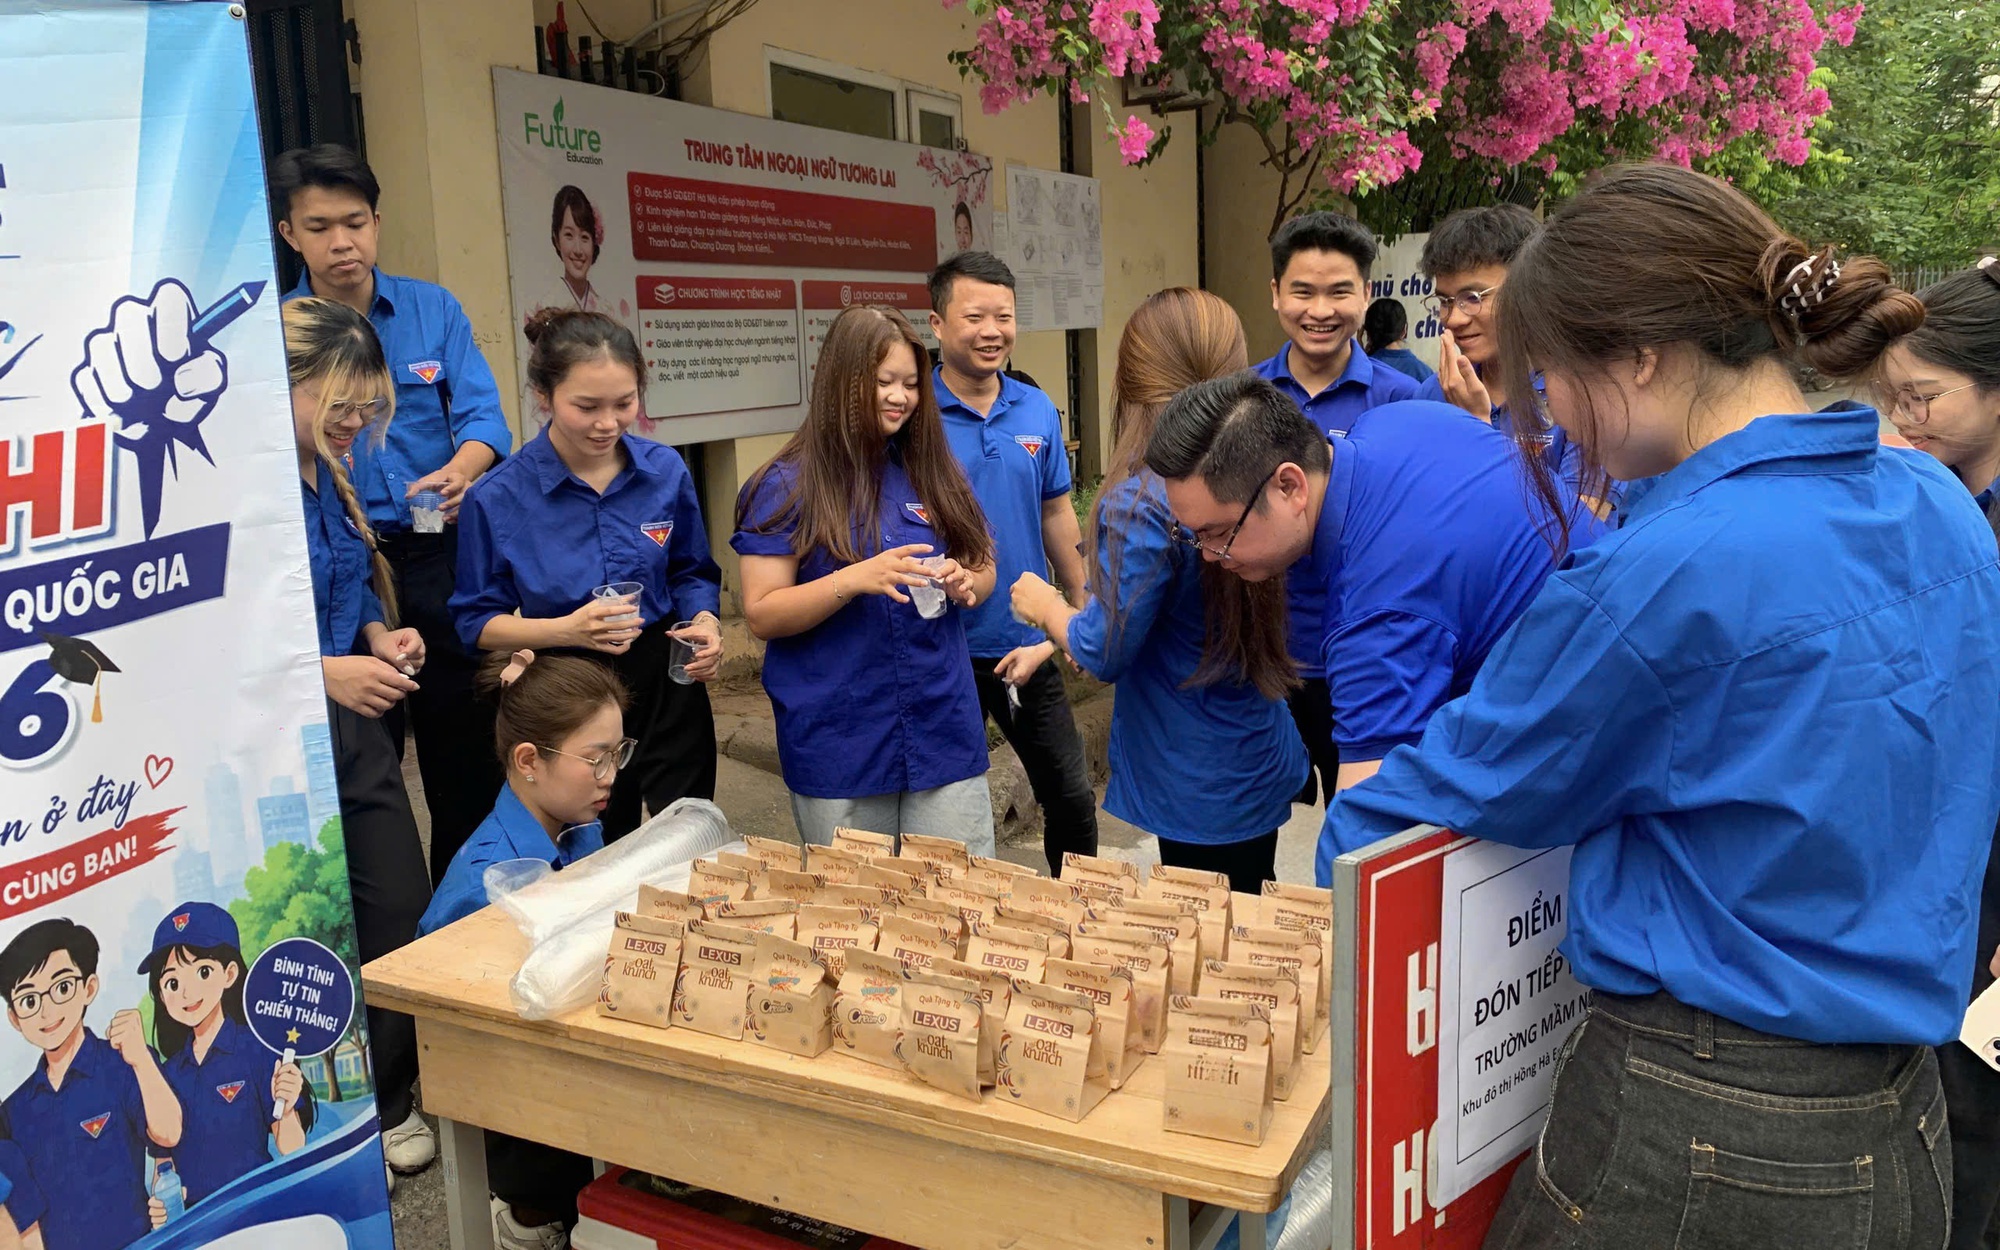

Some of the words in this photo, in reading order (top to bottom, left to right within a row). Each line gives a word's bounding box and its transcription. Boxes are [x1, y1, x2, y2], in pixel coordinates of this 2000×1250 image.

[524, 110, 601, 153] Future
[566, 151, 603, 165] Education
[684, 139, 733, 166] TRUNG
[736, 143, 764, 170] TÂM
[767, 151, 808, 181] NGOẠI
[811, 157, 837, 180] NGỮ
[839, 162, 877, 185] TƯƠNG
[879, 168, 896, 188] LAI
[673, 190, 696, 202] GD&ĐT
[649, 237, 669, 247] Thanh
[1400, 273, 1432, 297] cho
[678, 288, 709, 299] CHƯƠNG
[711, 286, 731, 299] TRÌNH
[731, 288, 746, 302] HỌC
[747, 286, 765, 299] TIẾNG
[766, 288, 782, 302] NHẬT
[853, 290, 863, 301] LỢI
[863, 289, 871, 300] ÍCH
[872, 291, 883, 300] CHO
[885, 291, 896, 303] HỌC
[896, 292, 908, 301] SINH
[655, 319, 664, 330] Sử
[664, 319, 680, 331] dụng
[681, 319, 696, 328] sách
[697, 319, 709, 331] giáo
[710, 319, 725, 328] khoa
[726, 319, 734, 327] do
[735, 319, 742, 329] Bộ
[743, 318, 762, 328] GD&ĐT
[763, 319, 775, 328] biên
[775, 320, 788, 329] soạn
[656, 339, 671, 349] Giáo
[672, 339, 684, 348] viên
[685, 338, 694, 348] tốt
[694, 337, 713, 350] nghiệp
[714, 337, 723, 348] đại
[724, 337, 734, 348] học
[735, 337, 754, 348] chuyên
[754, 336, 771, 346] ngành
[772, 335, 783, 346] tiếng
[784, 335, 796, 345] Nhật
[657, 359, 669, 370] Xây
[670, 358, 686, 369] dựng
[689, 358, 700, 367] các
[707, 357, 722, 367] năng
[723, 357, 733, 367] học
[734, 356, 749, 367] ngoại
[674, 370, 684, 380] viết
[687, 370, 698, 381] một
[700, 369, 715, 379] cách
[715, 368, 727, 379] hiệu
[4, 561, 121, 633] QUỐC
[132, 553, 190, 600] GIA
[43, 796, 68, 834] ở
[77, 774, 141, 829] đây
[3, 862, 76, 905] CÙNG
[84, 835, 137, 878] BẠN!
[818, 922, 832, 930] Quà
[834, 921, 849, 932] Tặng
[1507, 890, 1561, 948] ĐIỂM
[627, 940, 665, 954] LEXUS
[815, 937, 858, 950] LEXUS
[900, 933, 913, 942] Quà
[914, 936, 929, 947] Tặng
[701, 949, 740, 964] LEXUS
[773, 952, 785, 960] Quà
[786, 954, 800, 965] Tặng
[896, 950, 932, 968] LEXUS
[984, 955, 1027, 970] LEXUS
[273, 956, 304, 978] BÌNH
[307, 965, 334, 987] TĨNH
[623, 963, 656, 980] krunch
[634, 958, 653, 971] oat
[862, 962, 876, 971] Quà
[877, 964, 890, 975] Tặng
[950, 968, 963, 976] Quà
[698, 970, 733, 990] krunch
[711, 967, 730, 980] oat
[1066, 969, 1080, 977] Quà
[1081, 970, 1097, 982] Tặng
[282, 981, 300, 1001] TỰ
[301, 985, 321, 1004] TIN
[1475, 981, 1521, 1027] ĐÓN
[1526, 947, 1563, 1000] TIẾP
[919, 994, 933, 1003] Quà
[934, 995, 951, 1007] Tặng
[1031, 999, 1045, 1008] Quà
[1046, 1001, 1063, 1013] Tặng
[255, 999, 292, 1019] CHIẾN
[295, 1006, 338, 1032] THẮNG!
[915, 1012, 958, 1031] LEXUS
[1026, 1016, 1073, 1037] LEXUS
[927, 1035, 946, 1049] oat
[1036, 1038, 1057, 1054] oat
[1475, 1022, 1538, 1075] TRƯỜNG
[1541, 1002, 1575, 1037] MẦM
[917, 1038, 952, 1060] krunch
[1023, 1042, 1062, 1066] krunch
[1462, 1097, 1482, 1117] Khu
[1484, 1086, 1497, 1105] đô
[1498, 1075, 1512, 1095] thị
[1513, 1056, 1537, 1086] Hồng
[1538, 1050, 1551, 1070] Hà
